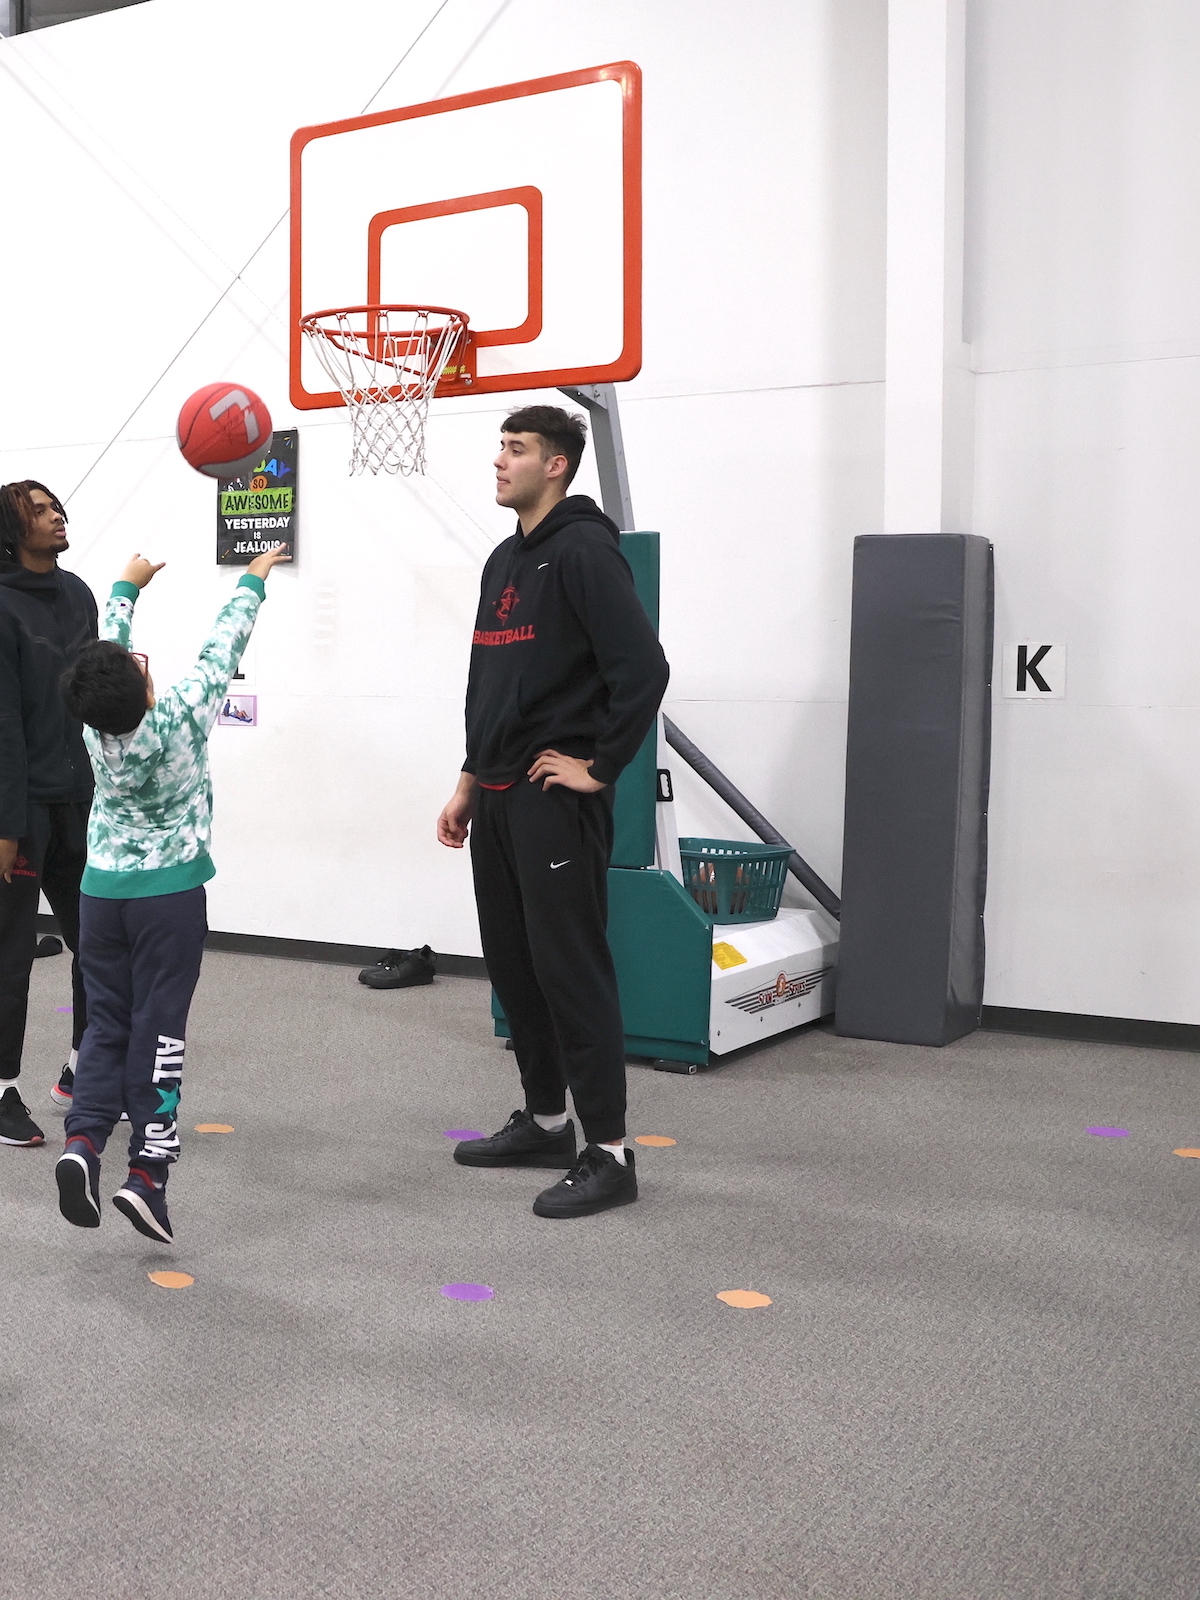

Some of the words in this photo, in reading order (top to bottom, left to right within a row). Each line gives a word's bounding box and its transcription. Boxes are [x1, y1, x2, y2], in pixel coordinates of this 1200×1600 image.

[253, 479, 264, 489] SO
[225, 493, 289, 511] AWESOME
[225, 517, 290, 530] YESTERDAY
[253, 531, 262, 540] IS
[233, 540, 281, 554] JEALOUS
[473, 624, 535, 646] BASKETBALL
[1016, 645, 1052, 692] K
[151, 1034, 185, 1084] ALL
